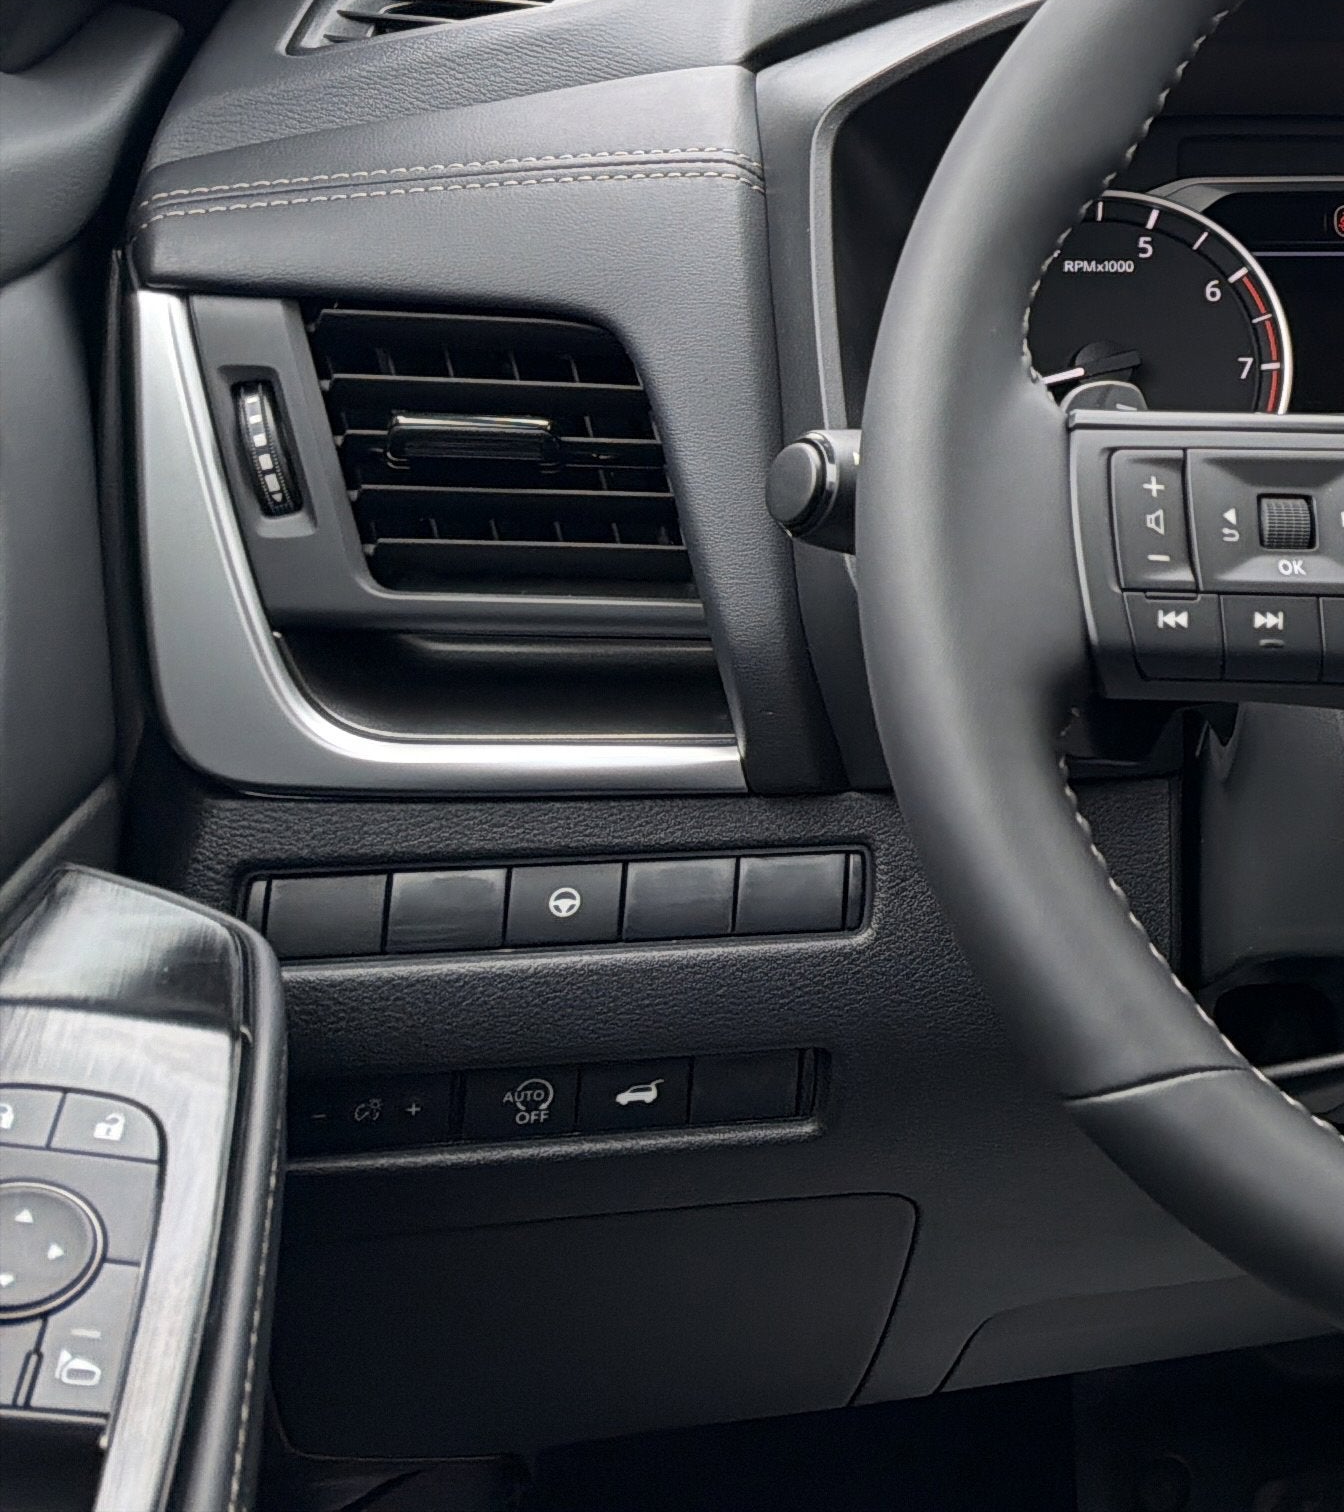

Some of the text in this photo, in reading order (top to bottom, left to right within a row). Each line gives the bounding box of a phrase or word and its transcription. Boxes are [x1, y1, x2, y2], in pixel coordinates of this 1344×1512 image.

[1137, 236, 1154, 258] 5
[1063, 259, 1135, 273] RPMx1000
[1205, 279, 1222, 302] 6
[1237, 356, 1254, 380] 7
[1277, 558, 1307, 576] OK
[502, 1089, 545, 1104] AUTO
[515, 1110, 550, 1125] OFF
